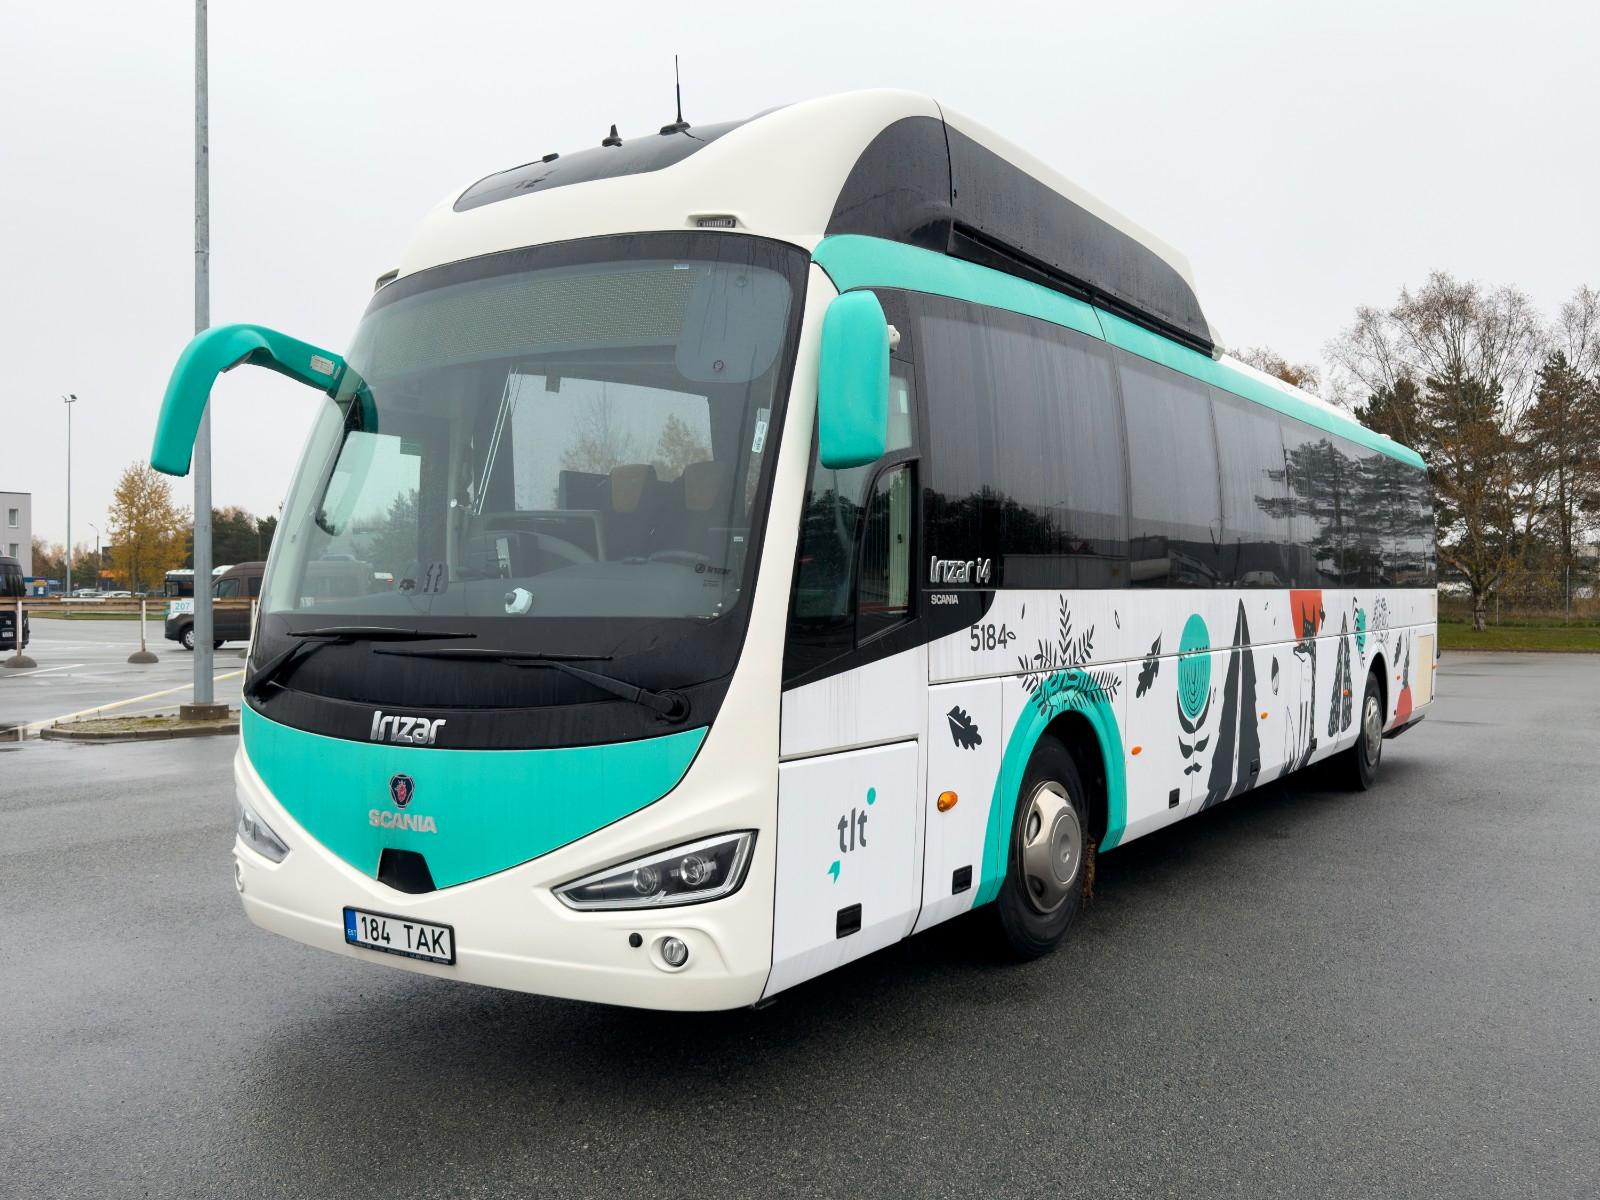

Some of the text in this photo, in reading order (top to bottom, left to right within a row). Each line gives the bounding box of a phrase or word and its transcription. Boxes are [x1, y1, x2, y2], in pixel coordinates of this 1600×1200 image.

[930, 555, 991, 584] Irizar i4
[175, 602, 191, 610] 207
[930, 594, 959, 605] SCANIA
[970, 623, 1008, 652] 5184
[370, 710, 447, 745] Irizar
[368, 809, 438, 834] SCANIA
[837, 807, 868, 853] tlt
[361, 916, 446, 955] 184 TAK
